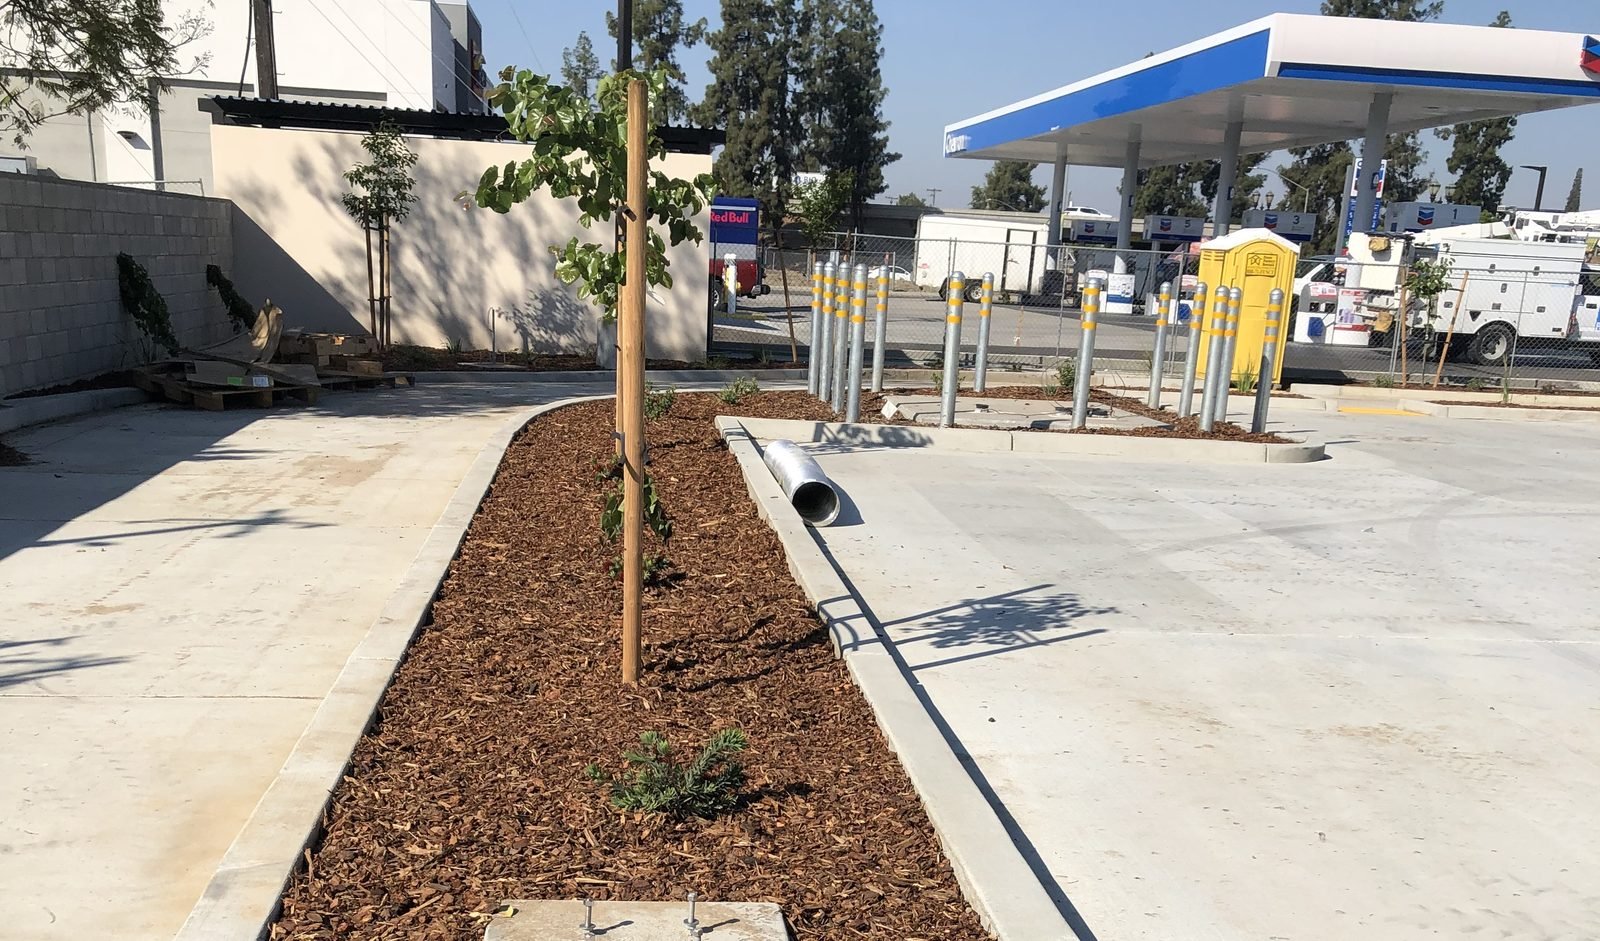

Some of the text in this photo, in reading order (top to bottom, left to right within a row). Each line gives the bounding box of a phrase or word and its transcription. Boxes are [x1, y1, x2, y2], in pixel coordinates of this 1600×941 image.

[710, 212, 749, 223] Red Bull
[1452, 208, 1458, 220] 1
[1184, 220, 1191, 228] 5
[1292, 215, 1300, 225] 3
[1106, 222, 1112, 230] 7
